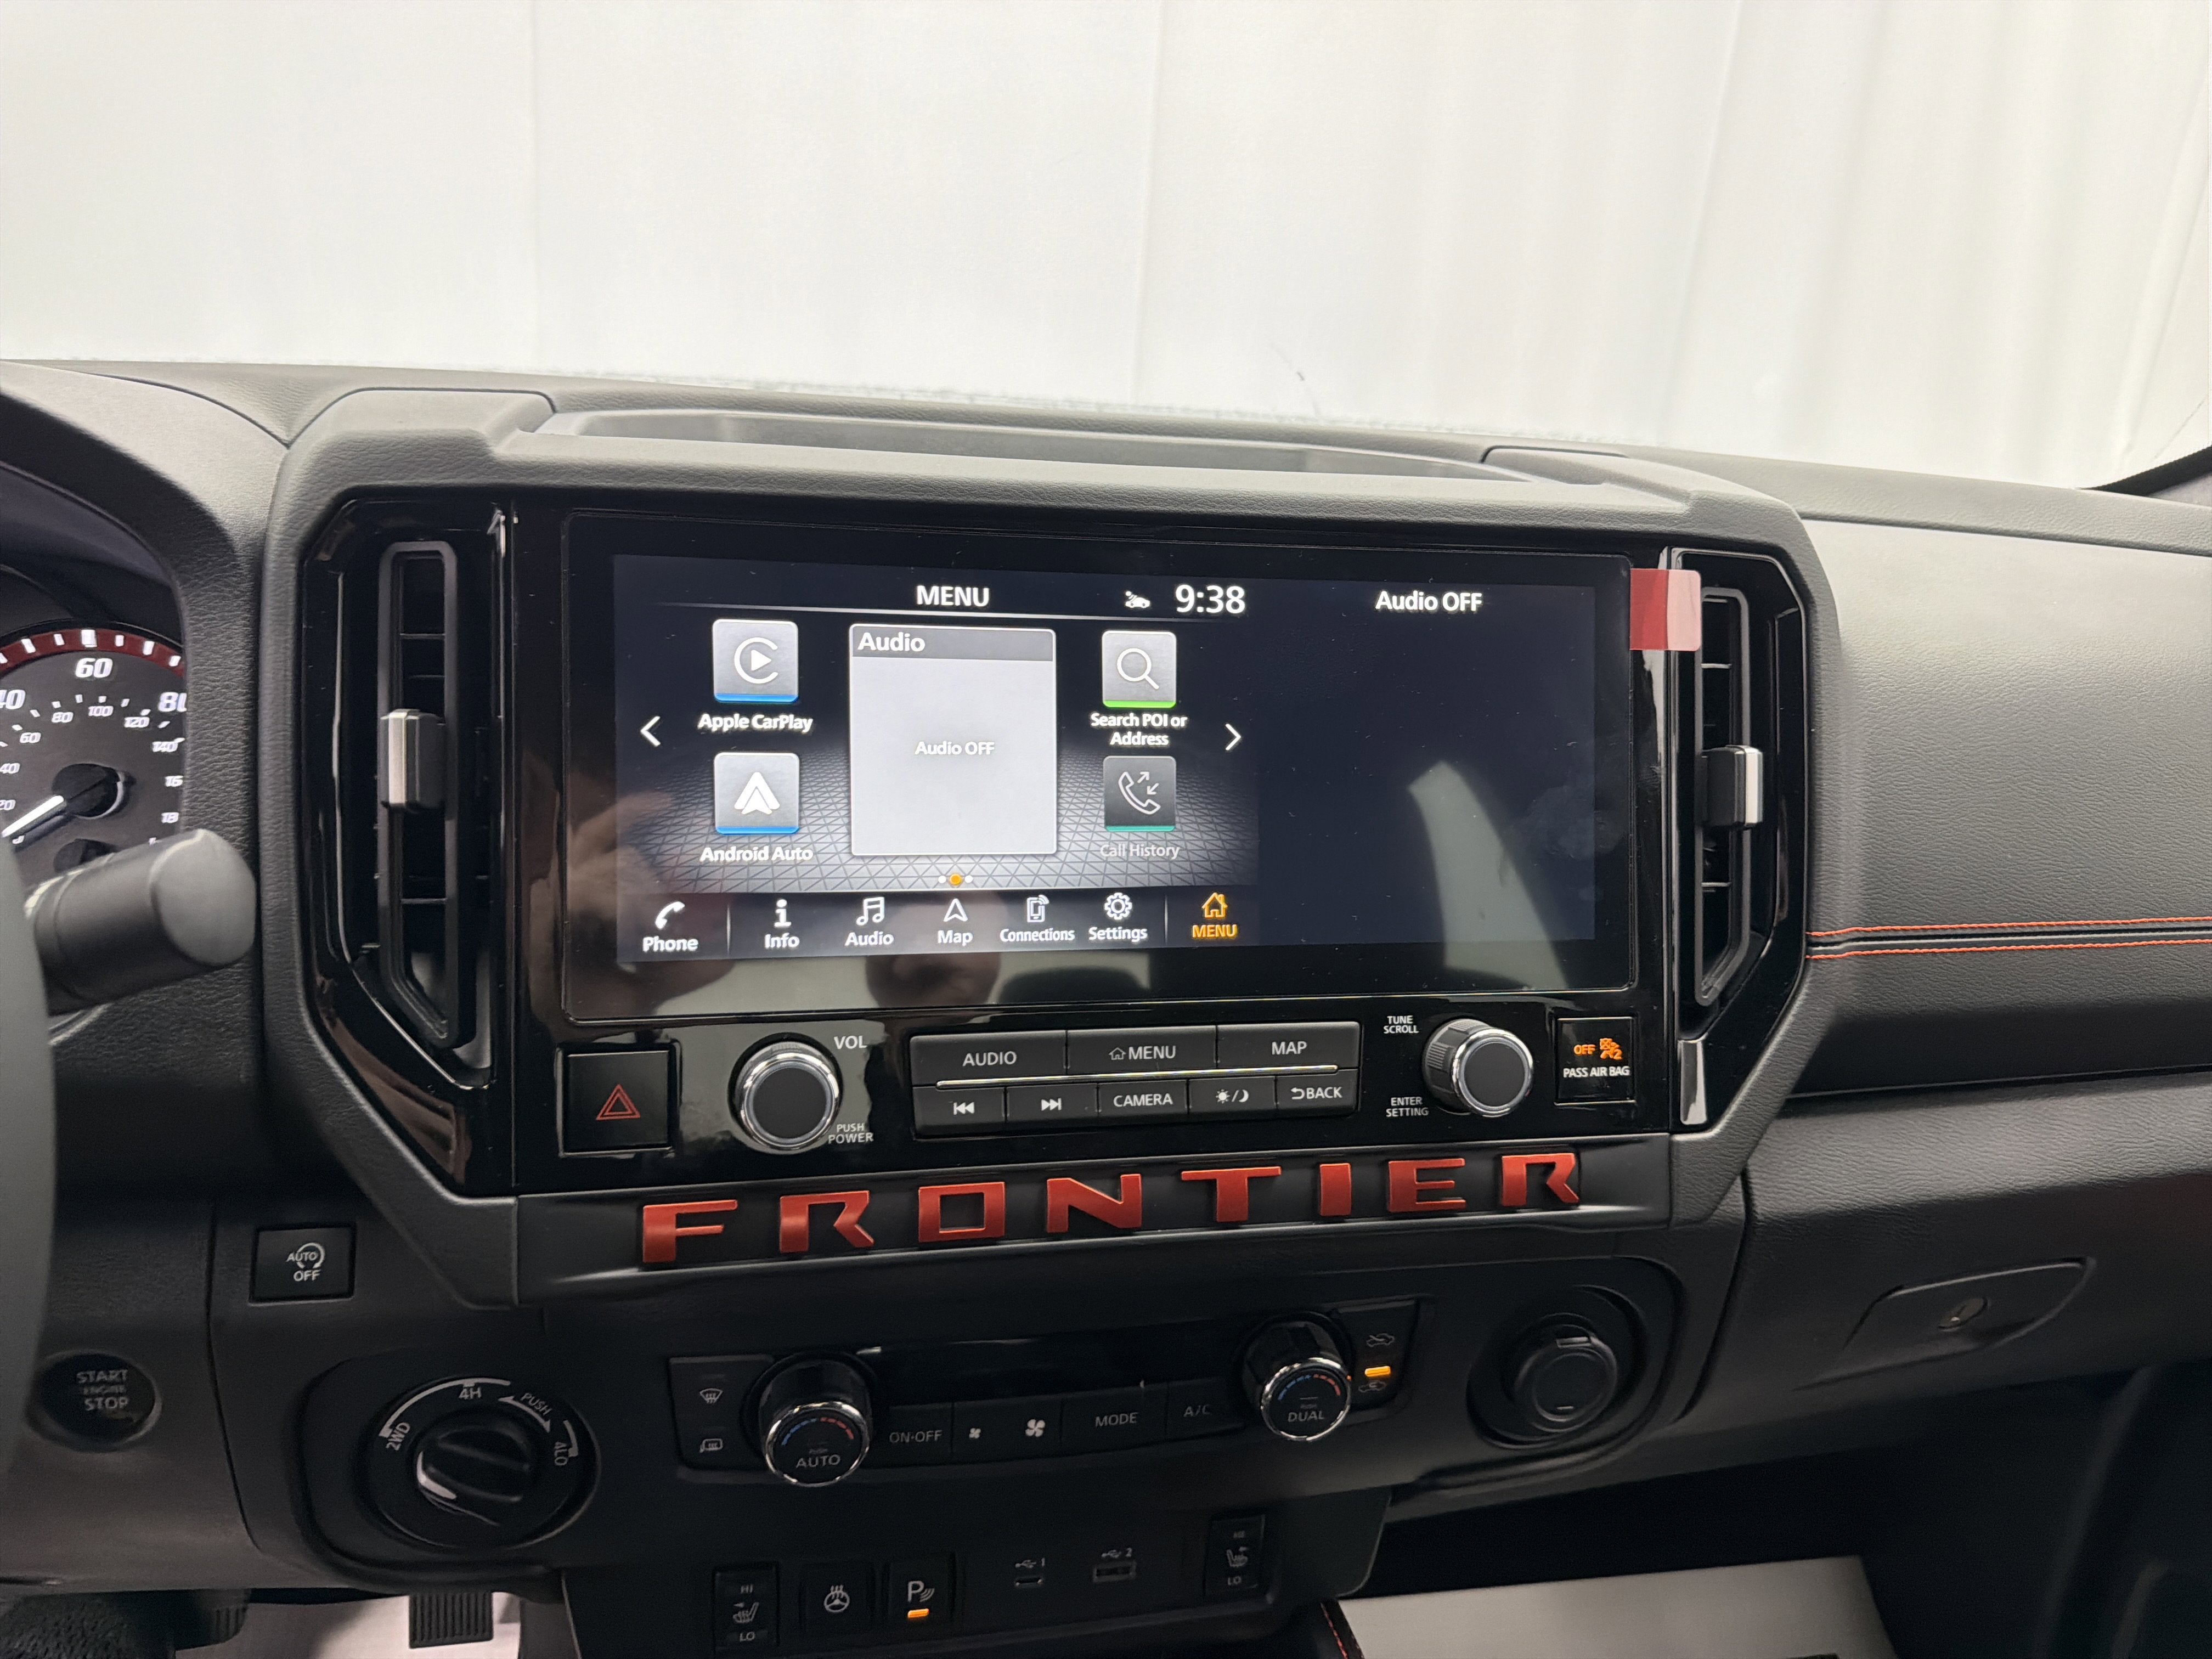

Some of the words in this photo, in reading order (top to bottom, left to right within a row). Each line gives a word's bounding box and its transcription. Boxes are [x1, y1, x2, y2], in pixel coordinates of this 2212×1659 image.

[916, 585, 990, 608] MENU
[1175, 584, 1246, 614] 9:38
[1375, 590, 1438, 612] Audio
[1442, 592, 1482, 612] OFF
[858, 632, 926, 652] Audio
[75, 658, 113, 678] 60
[52, 712, 74, 723] 80
[88, 706, 113, 716] 100
[124, 716, 149, 727] 120
[698, 714, 749, 730] Apple
[752, 714, 813, 732] CarPlay
[1091, 713, 1139, 727] Search
[1142, 714, 1168, 727] POI
[1171, 716, 1188, 727] or
[20, 732, 41, 743] 60
[1110, 732, 1169, 746] Address
[152, 741, 178, 752] 140
[915, 742, 962, 755] Audio
[965, 742, 995, 755] OFF
[699, 847, 769, 862] Android
[771, 847, 813, 861] Auto
[1100, 843, 1126, 857] Call
[1129, 844, 1180, 860] History
[938, 930, 973, 946] Map
[1000, 928, 1075, 942] Connections
[1088, 927, 1148, 942] Settings
[1192, 924, 1237, 939] MENU
[643, 937, 698, 952] Phone
[765, 934, 800, 949] Info
[845, 932, 894, 947] Audio
[1387, 1015, 1413, 1025] TUNE
[1383, 1025, 1419, 1034] SCROLL
[834, 1035, 867, 1050] VOL
[1271, 1041, 1307, 1056] MAP
[1128, 1046, 1177, 1060] MENU
[1573, 1045, 1595, 1056] OFF
[962, 1051, 1017, 1068] AUDIO
[1563, 1068, 1588, 1077] PASS
[1590, 1066, 1608, 1076] AIR
[1609, 1066, 1630, 1076] BAG
[1306, 1087, 1342, 1099] BACK
[1113, 1093, 1173, 1108] CAMERA
[1391, 1097, 1423, 1107] ENTER
[1386, 1107, 1429, 1117] SETTING
[836, 1123, 865, 1132] PUSH
[827, 1132, 874, 1144] POWER
[643, 1153, 1580, 1263] FRONTIER
[286, 1251, 318, 1262] AUTO
[294, 1269, 321, 1282] OFF
[76, 1369, 128, 1383] START
[459, 1387, 482, 1400] 4H
[84, 1396, 129, 1411] STOP
[521, 1392, 552, 1416] PUSH
[1096, 1412, 1138, 1427] MODE
[1288, 1410, 1324, 1422] DUAL
[386, 1422, 411, 1451] 2WD
[795, 1454, 840, 1469] AUTO
[740, 1584, 753, 1594] HI
[740, 1632, 755, 1641] LO
